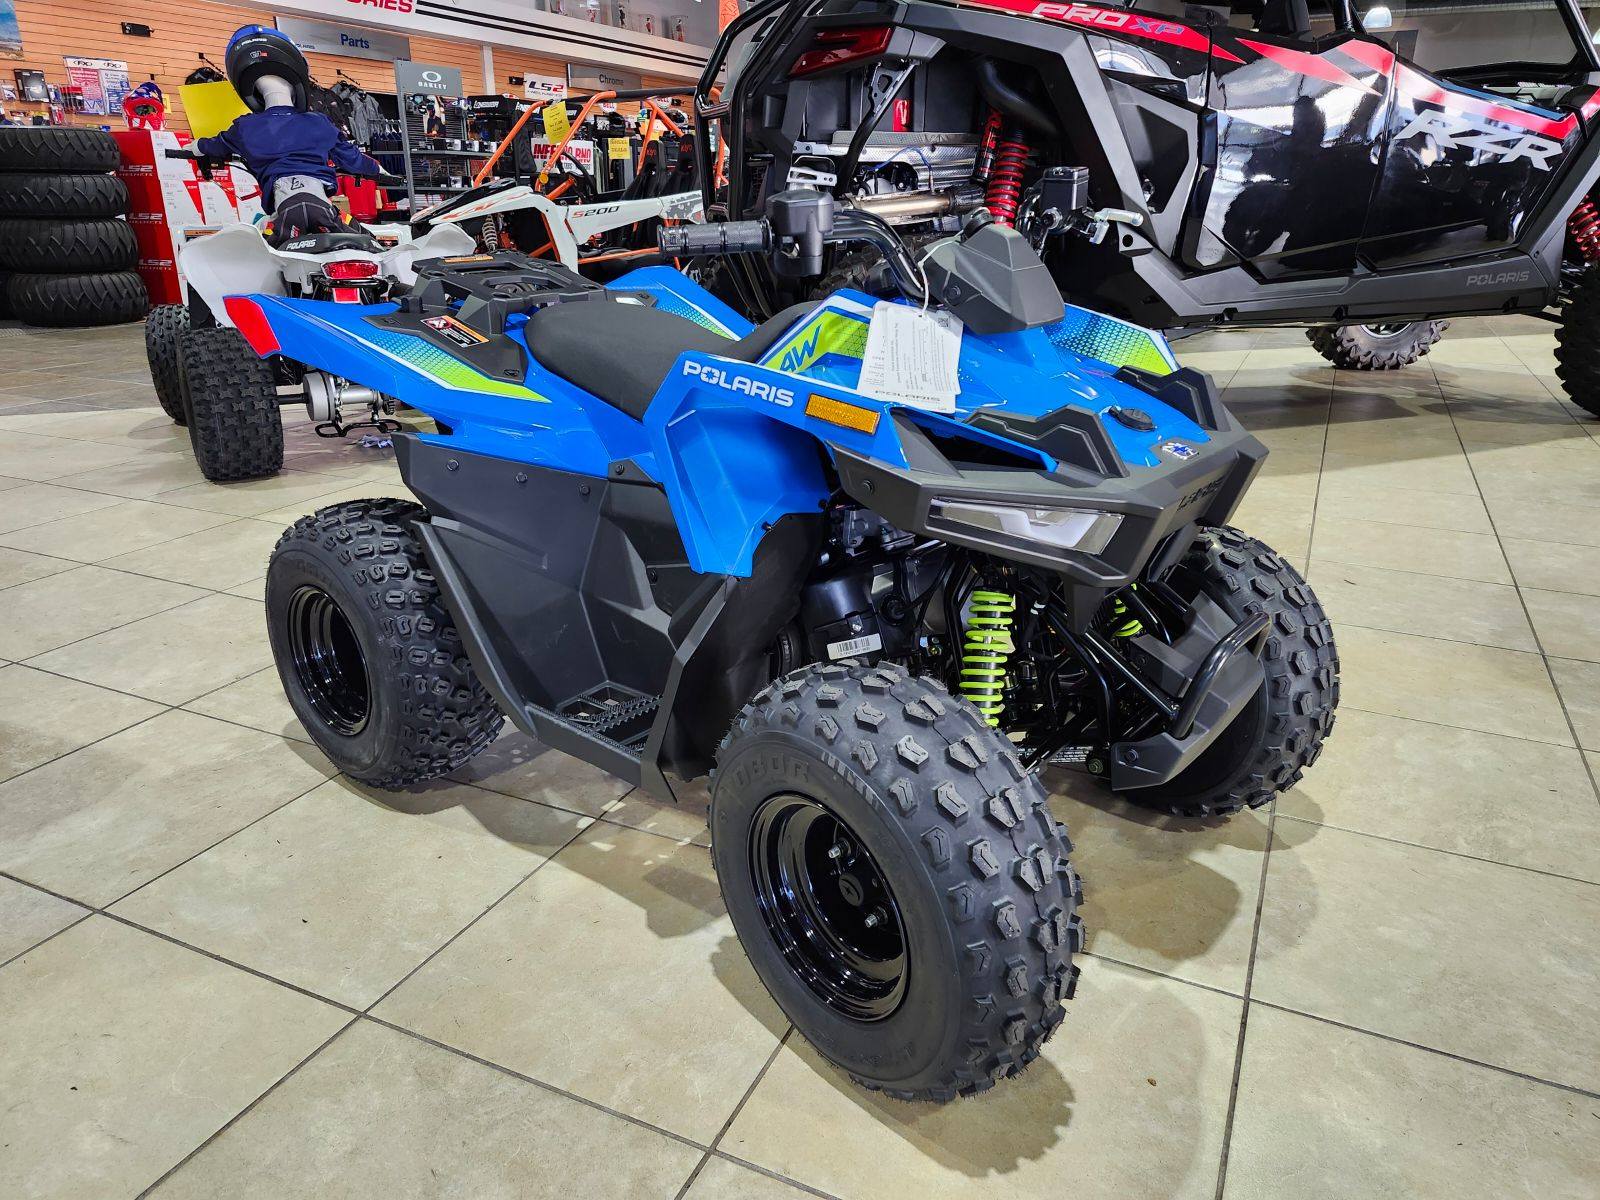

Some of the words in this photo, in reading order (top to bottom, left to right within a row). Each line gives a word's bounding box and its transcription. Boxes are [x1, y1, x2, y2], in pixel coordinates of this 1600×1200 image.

[1032, 3, 1130, 27] PRO
[1129, 16, 1184, 34] XP
[341, 33, 370, 49] Parts
[418, 81, 447, 90] OAKLEY
[528, 80, 564, 93] LS2
[599, 74, 625, 87] Chrome
[1393, 109, 1562, 171] RZR
[572, 205, 620, 219] S200
[286, 239, 316, 250] POLARIS
[1466, 271, 1530, 286] POLARIS
[683, 360, 795, 407] POLARIS
